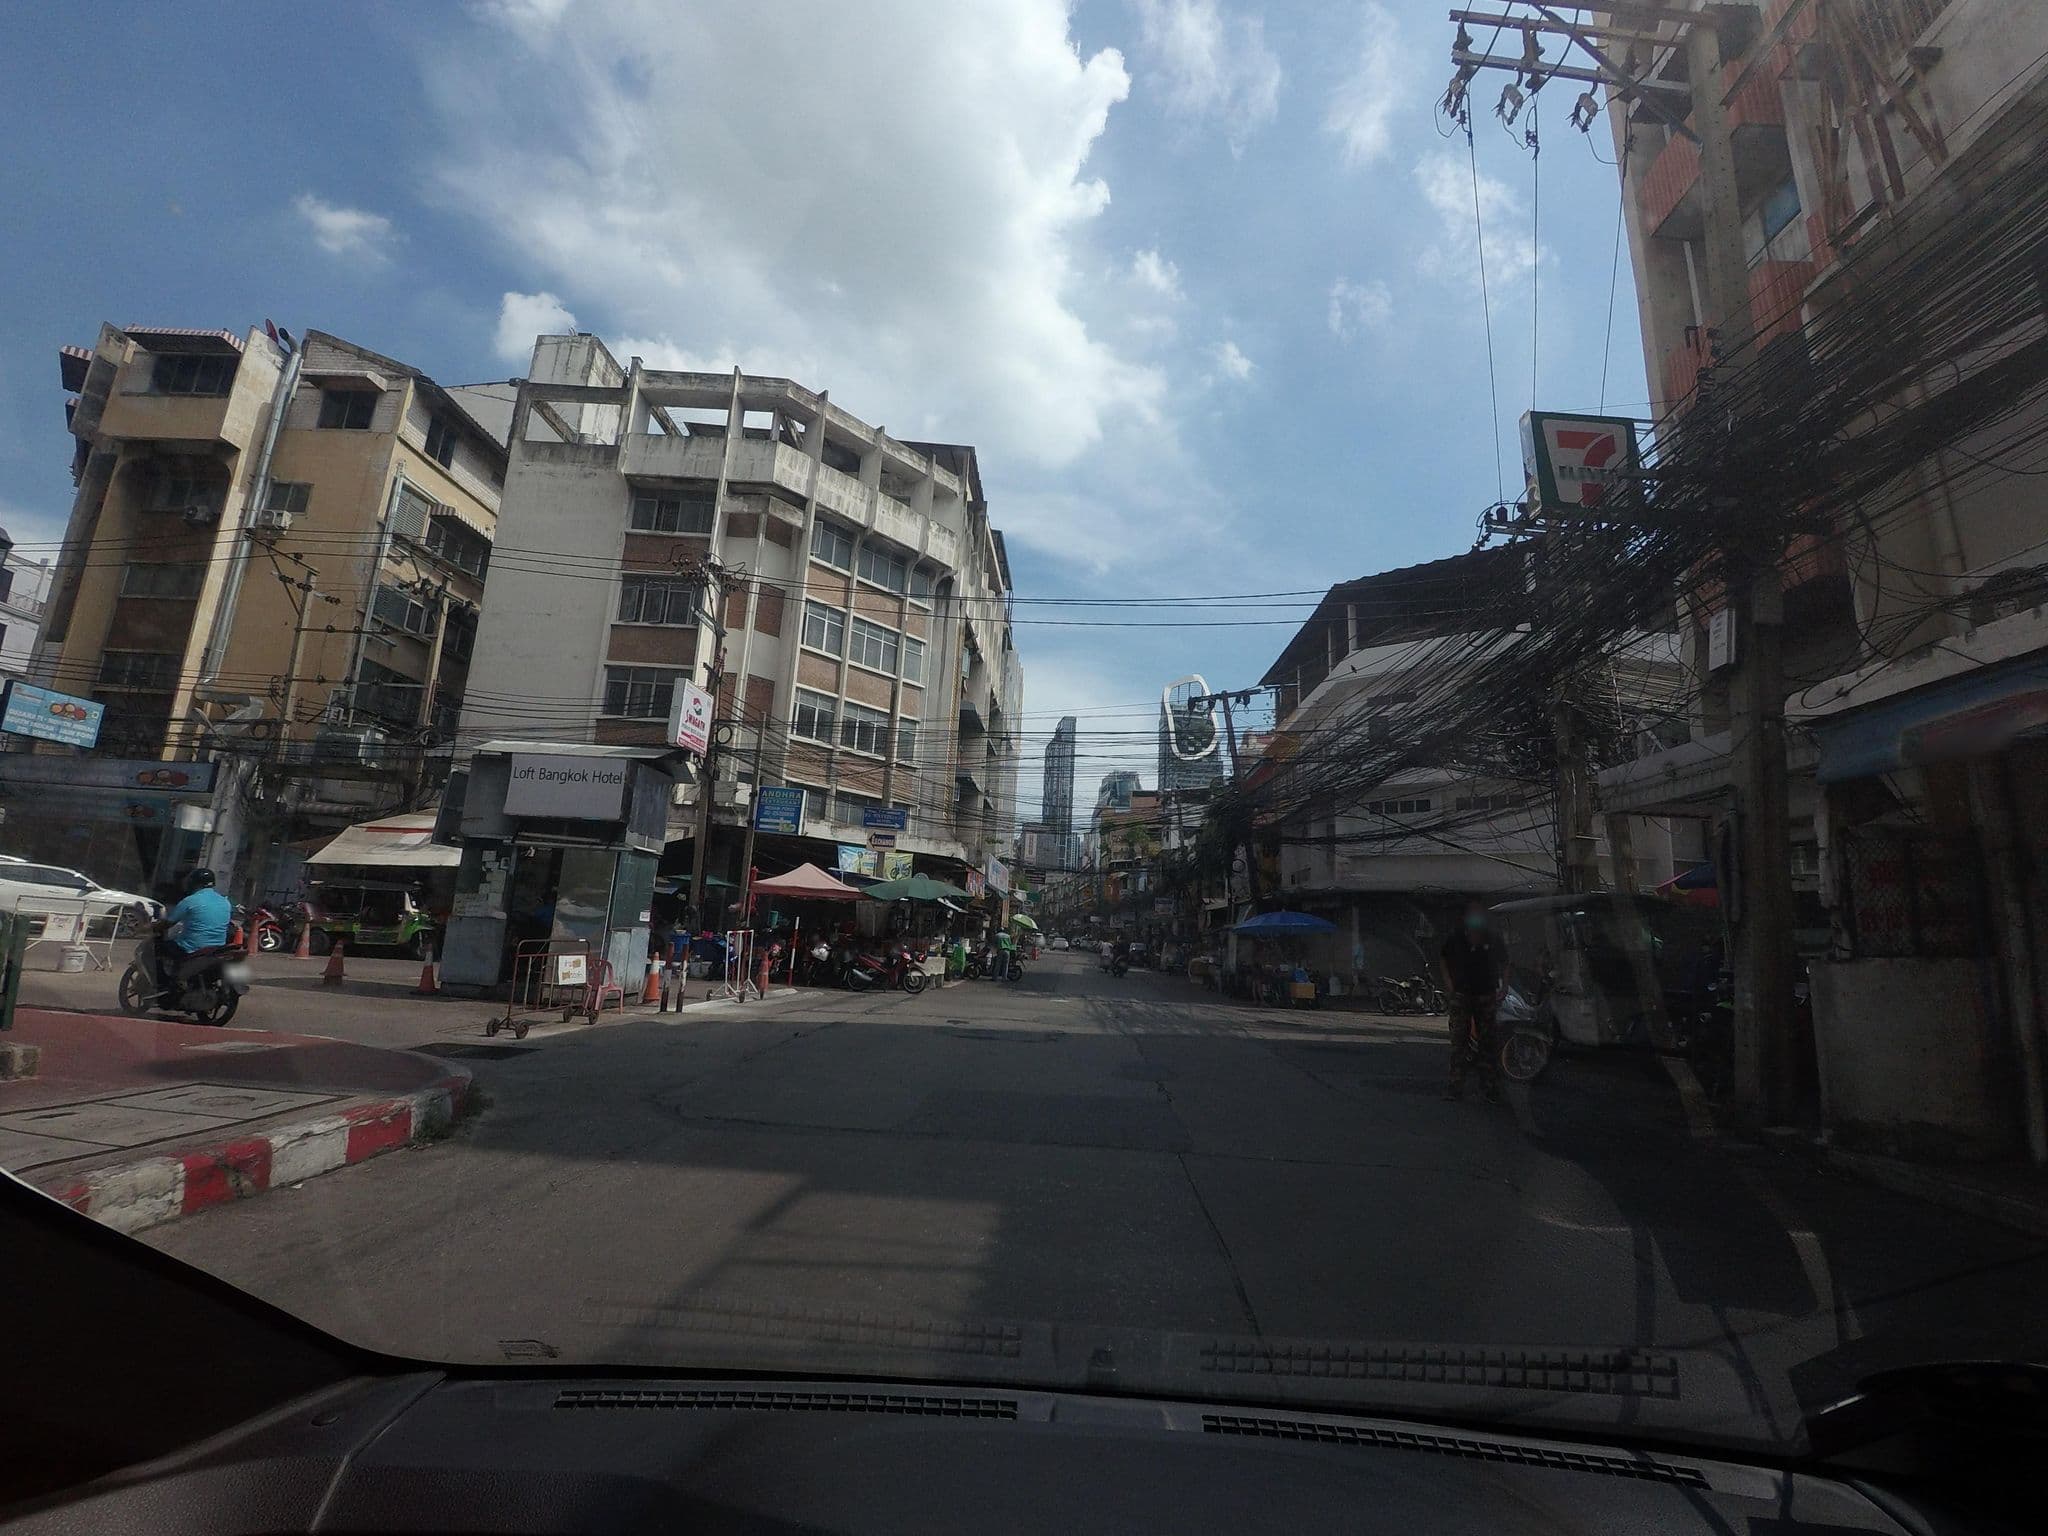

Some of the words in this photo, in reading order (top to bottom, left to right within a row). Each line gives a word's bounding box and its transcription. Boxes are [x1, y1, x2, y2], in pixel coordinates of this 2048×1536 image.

[1556, 430, 1616, 508] 7
[513, 766, 535, 780] Loft
[538, 767, 588, 785] Bangkok
[592, 770, 623, 785] Hotel
[762, 790, 801, 800] ANDHRA
